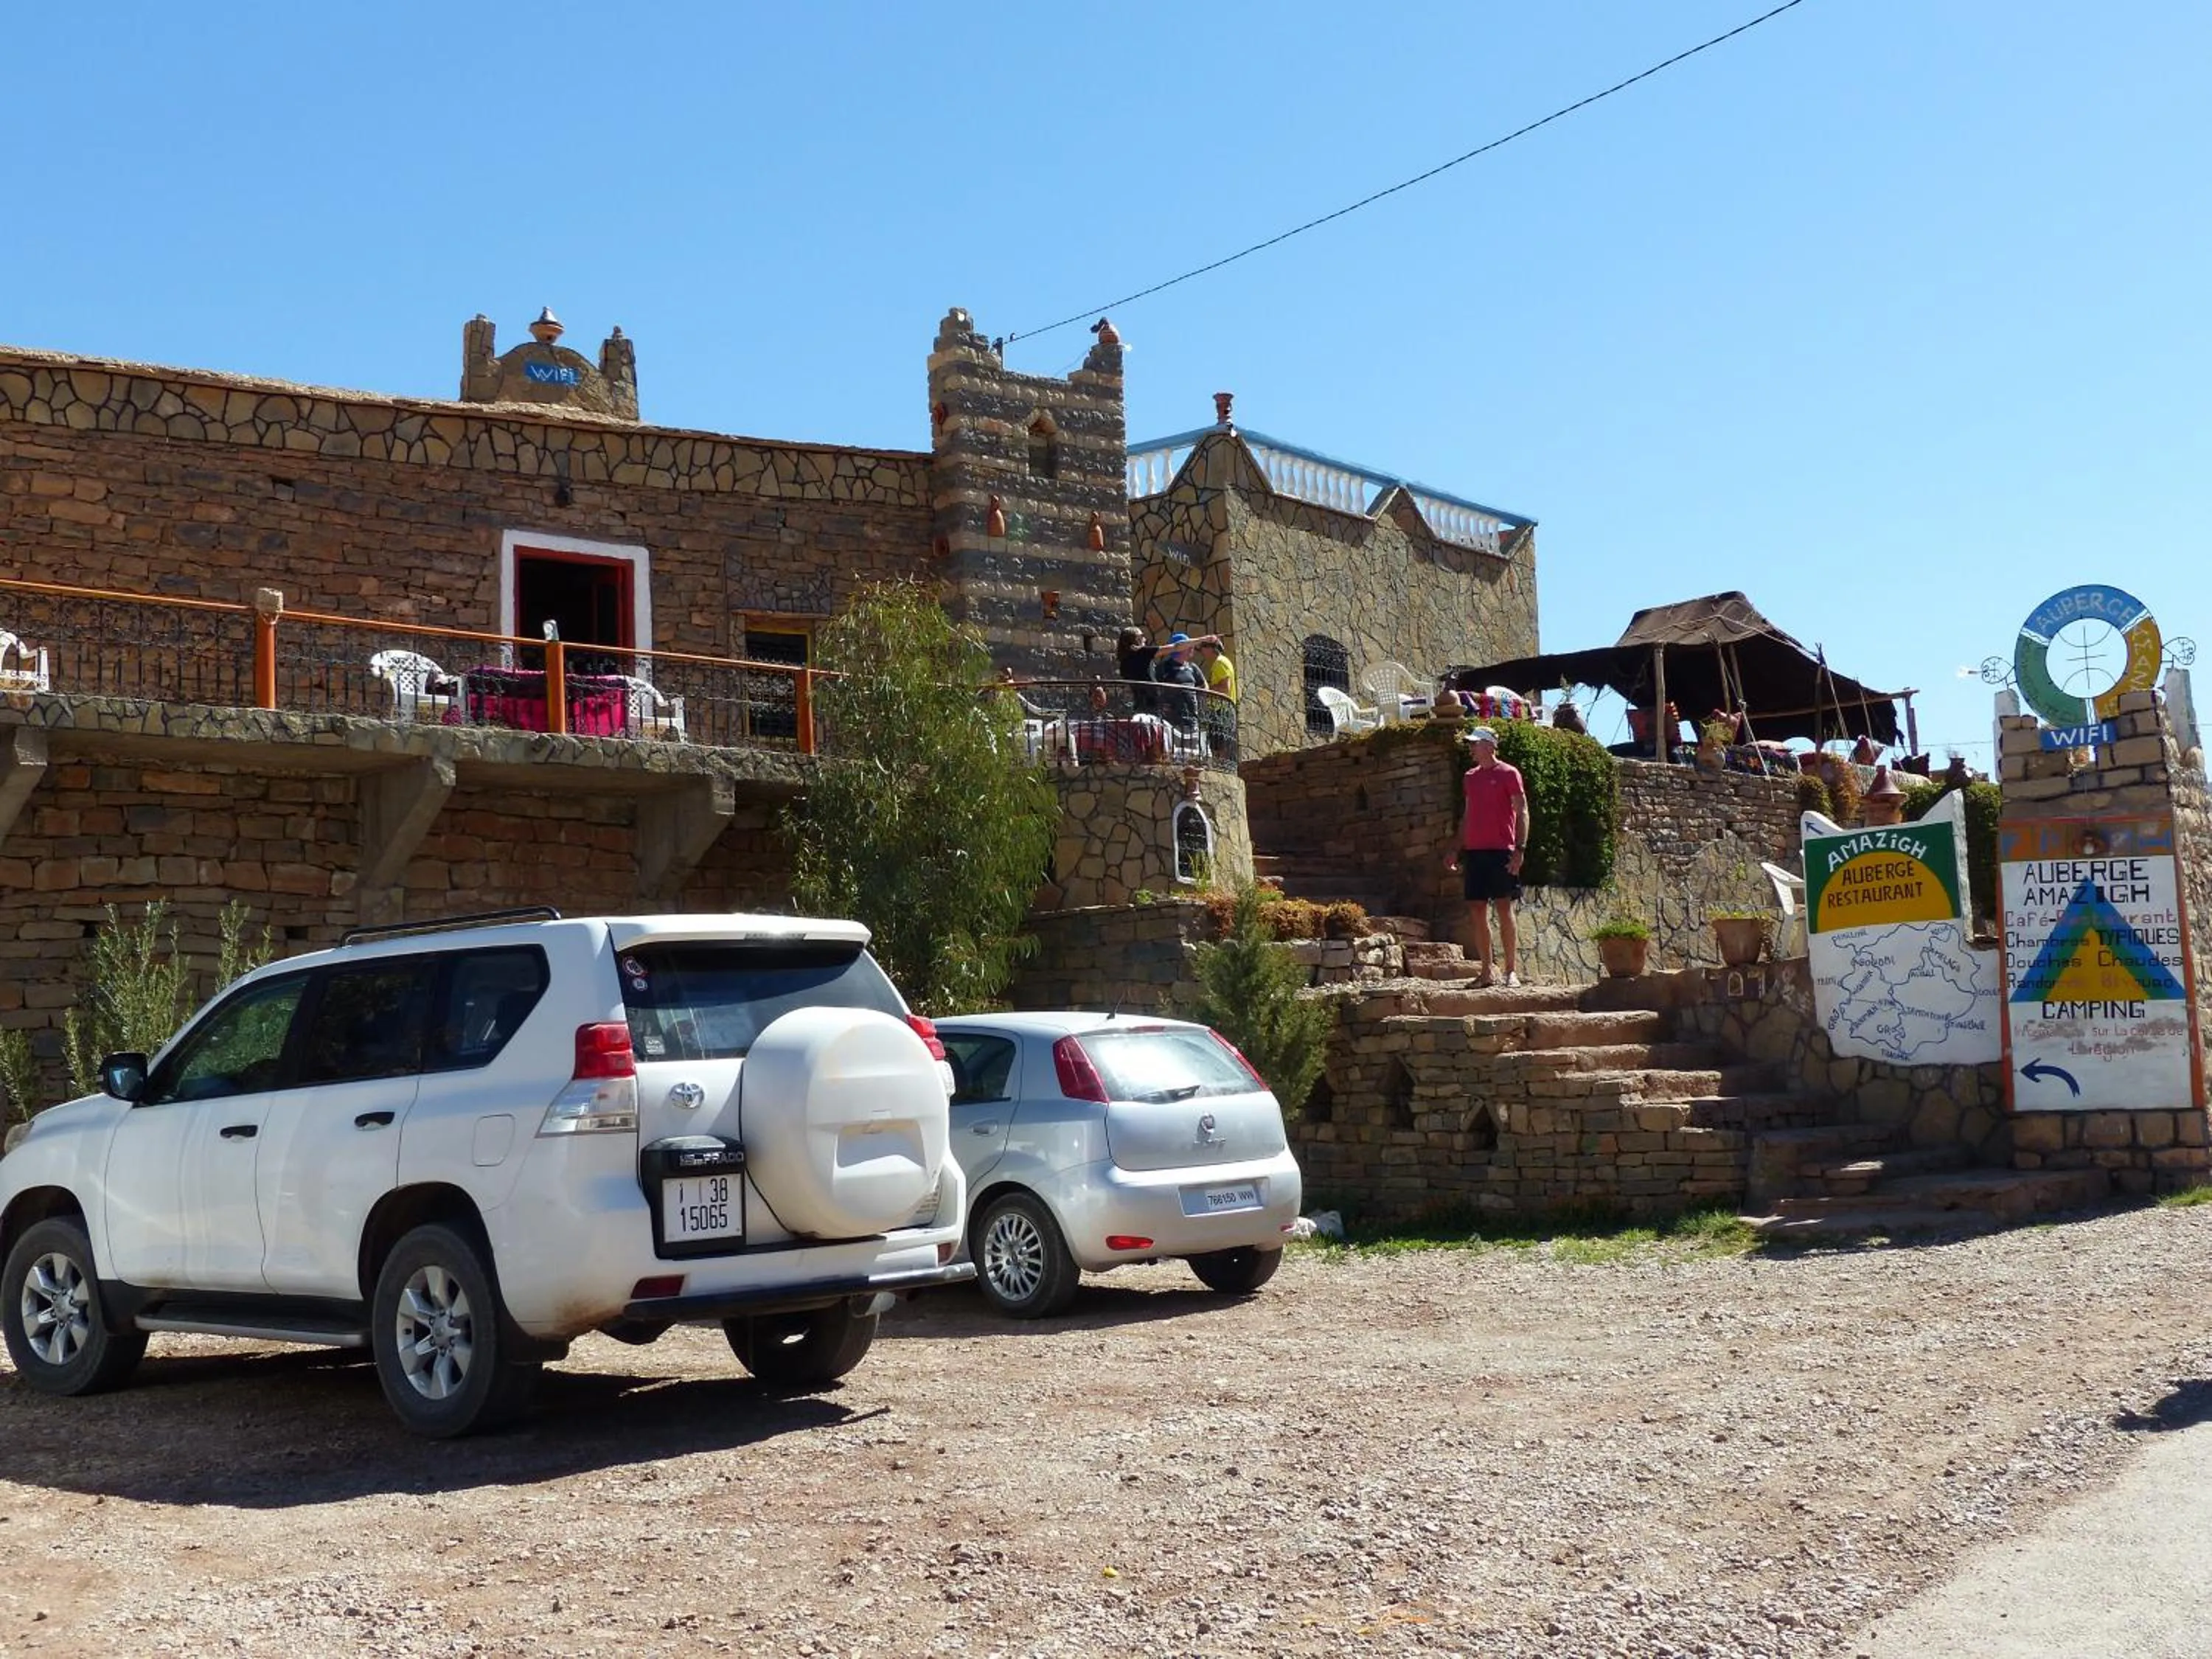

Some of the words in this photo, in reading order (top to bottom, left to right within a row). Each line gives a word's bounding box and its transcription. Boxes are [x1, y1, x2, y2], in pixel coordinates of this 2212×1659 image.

[530, 365, 577, 385] WIFI
[2051, 725, 2108, 745] WIFI
[1843, 860, 1915, 886] AUBERGE
[2024, 859, 2149, 884] AUBERGE
[1828, 882, 1923, 908] RESTAURANT
[2042, 1001, 2145, 1019] CAMPING
[710, 1178, 728, 1203] 38
[681, 1204, 728, 1232] 15065
